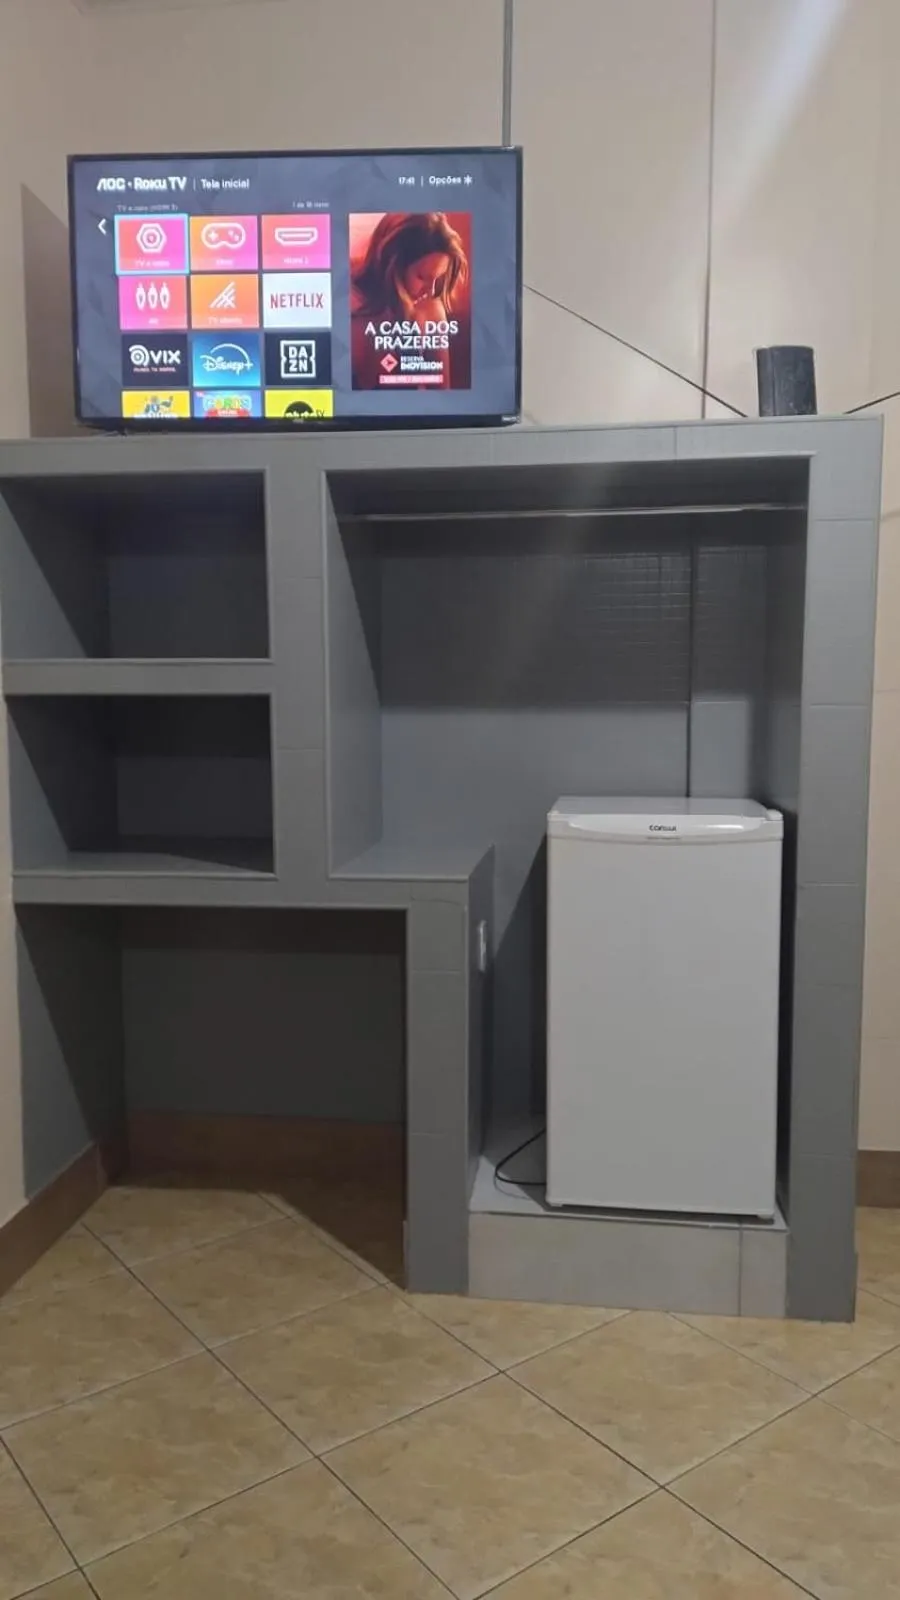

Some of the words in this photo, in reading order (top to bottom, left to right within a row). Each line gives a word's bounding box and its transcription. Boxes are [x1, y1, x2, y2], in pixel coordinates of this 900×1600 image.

[169, 175, 187, 190] TV
[201, 178, 220, 189] Tela
[222, 178, 250, 189] inicial
[270, 293, 324, 309] NETFLIX
[365, 321, 376, 335] A
[380, 321, 421, 335] CASA
[425, 320, 458, 334] DOS
[374, 335, 449, 350] PRAZERES
[149, 350, 181, 365] VIX
[288, 346, 308, 358] DA
[288, 359, 308, 372] ZN
